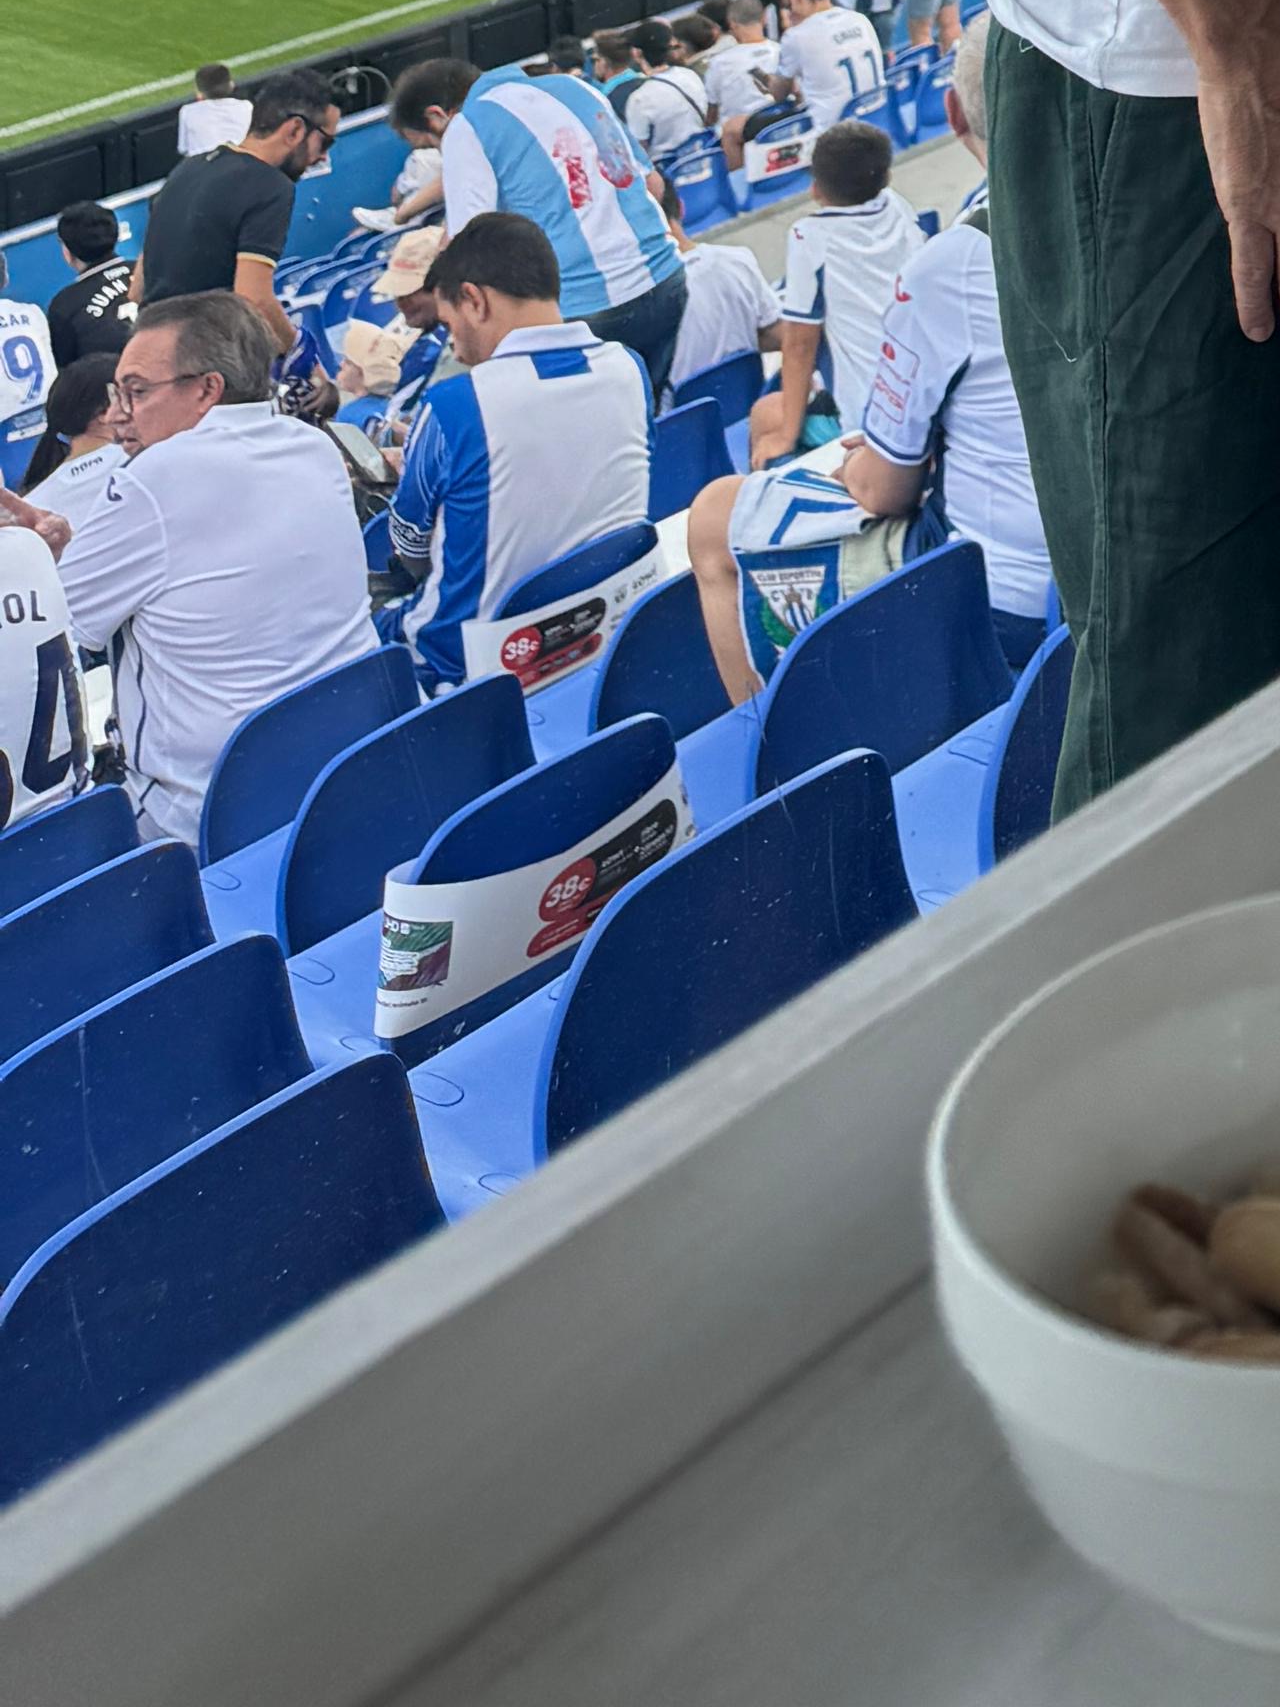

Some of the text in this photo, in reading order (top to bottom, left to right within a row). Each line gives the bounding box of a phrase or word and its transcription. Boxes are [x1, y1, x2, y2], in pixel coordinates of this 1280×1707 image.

[837, 50, 879, 95] 11
[86, 279, 128, 317] JUAN
[0, 590, 47, 628] OL
